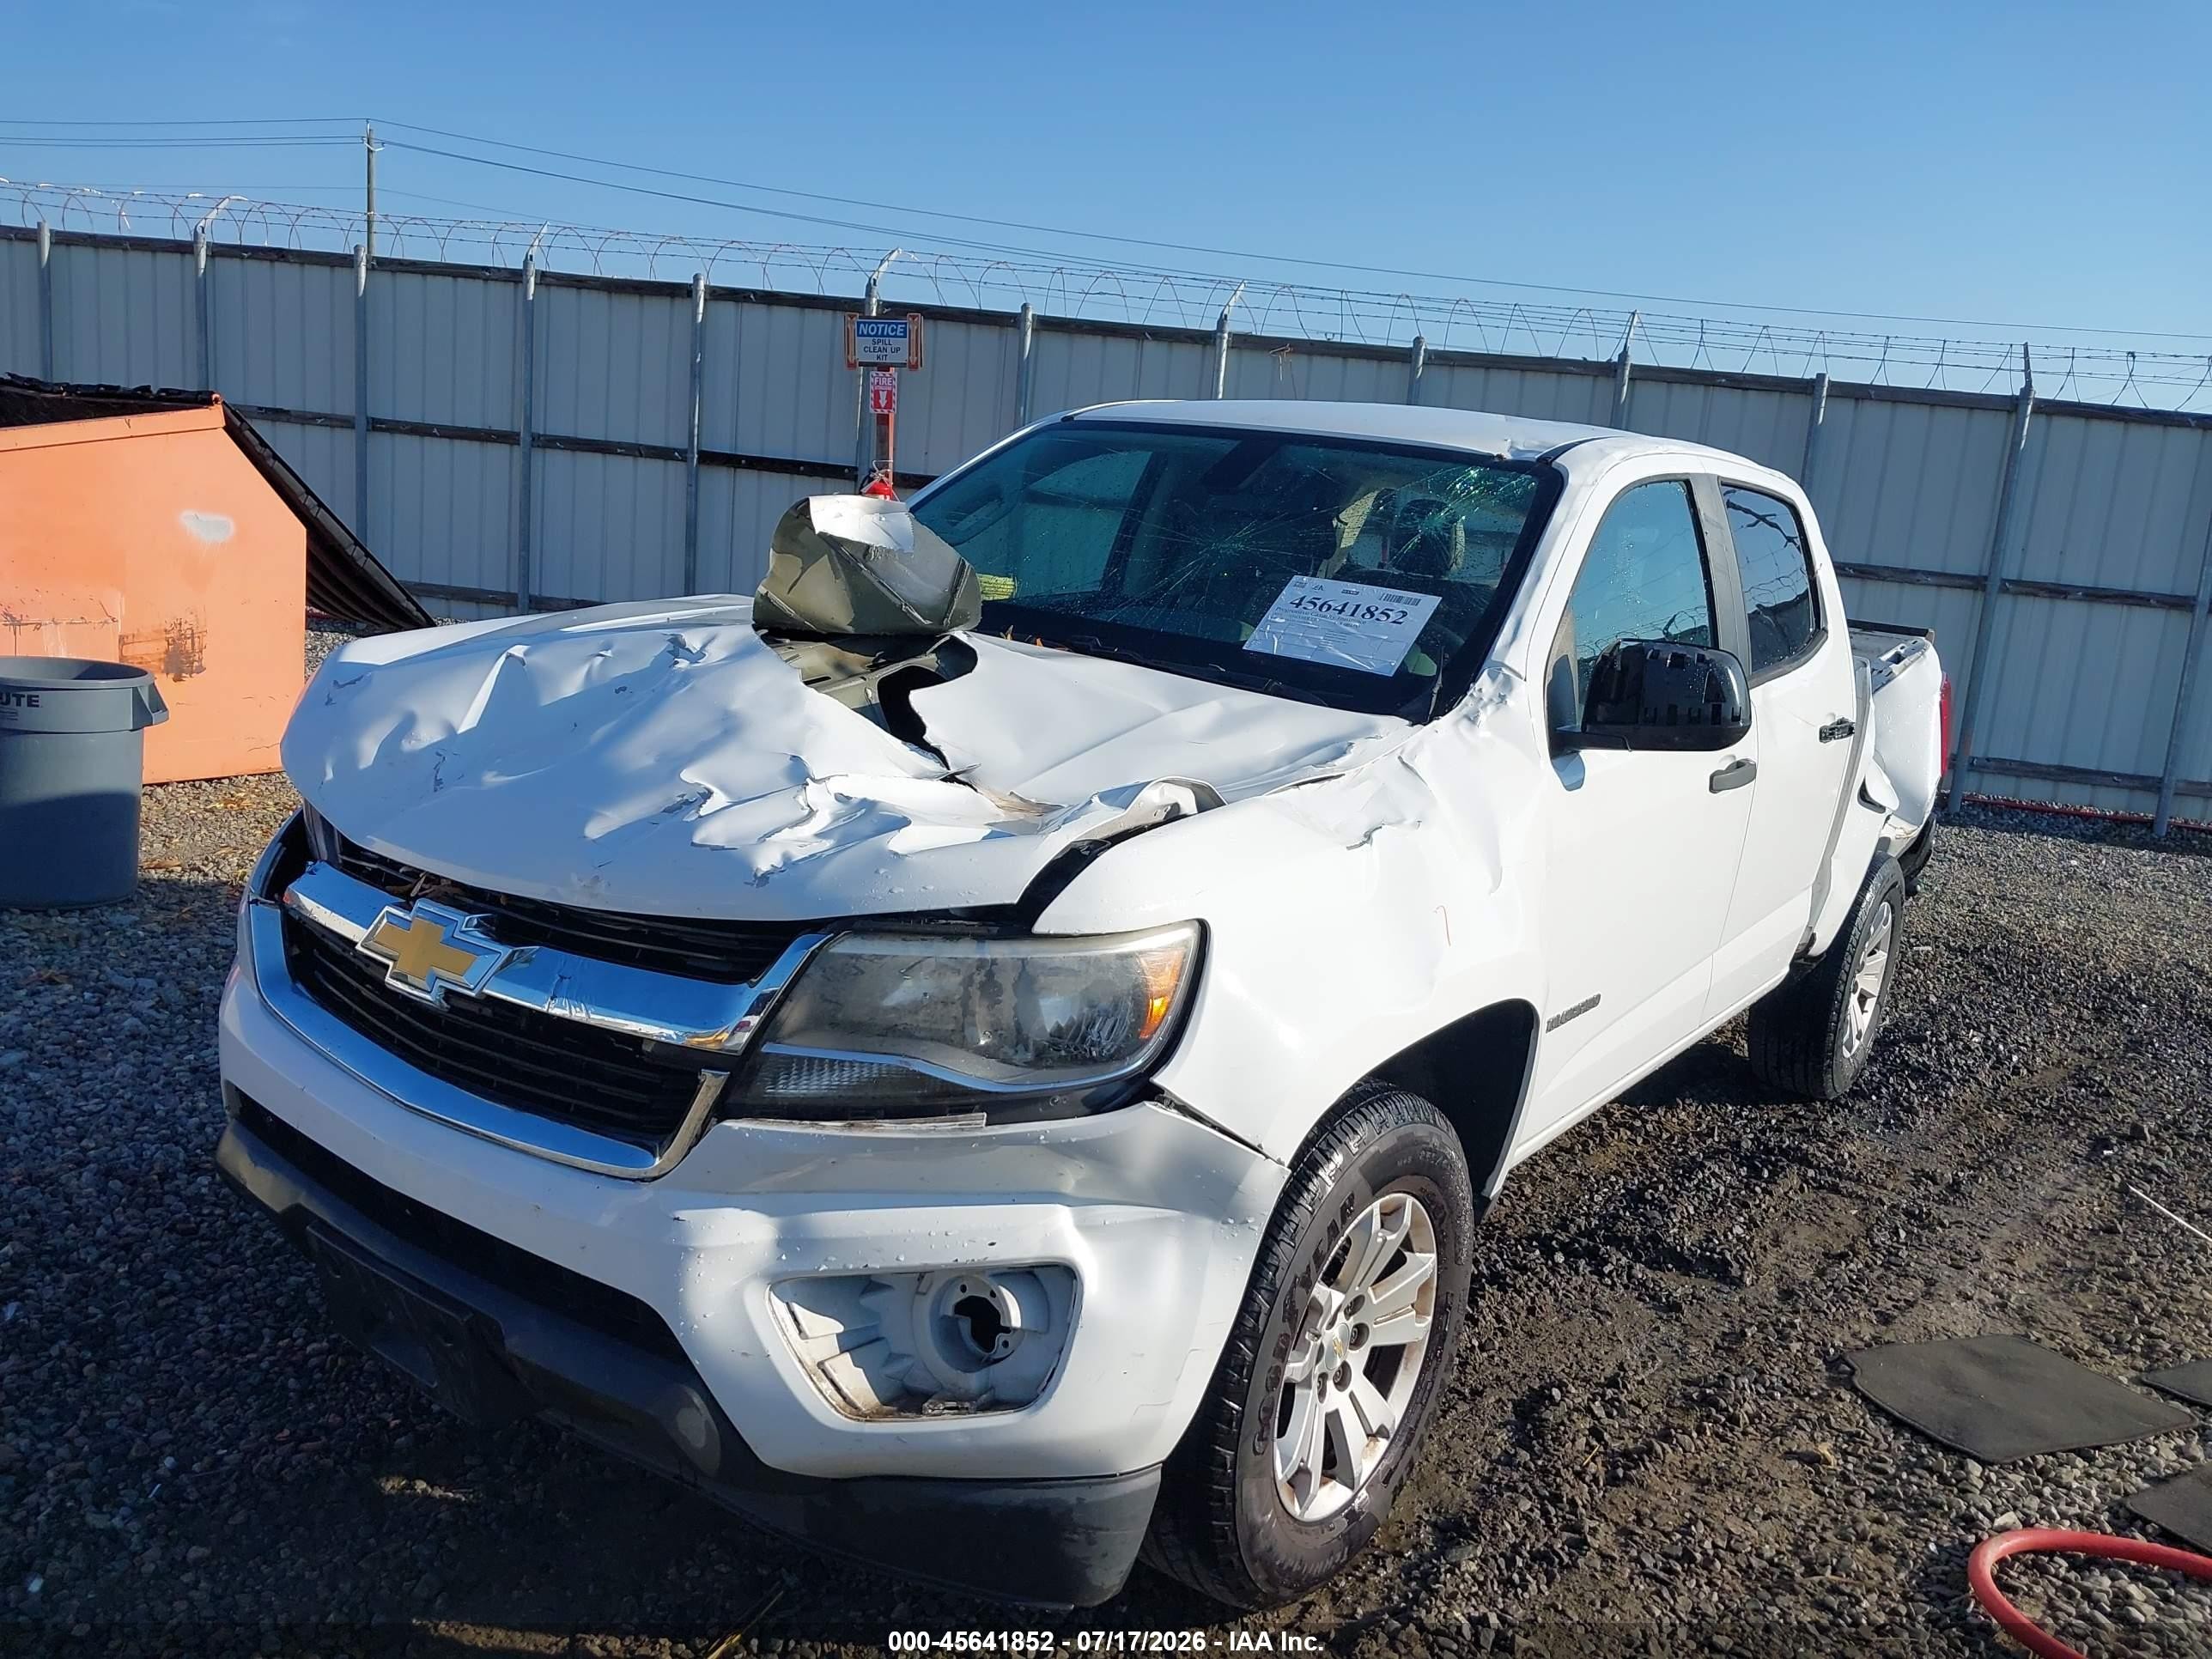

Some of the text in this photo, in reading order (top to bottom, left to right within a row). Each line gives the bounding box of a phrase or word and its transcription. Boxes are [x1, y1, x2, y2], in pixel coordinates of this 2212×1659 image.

[859, 323, 906, 336] NOTICE
[874, 377, 892, 386] FIRE
[1289, 594, 1408, 625] 45641852
